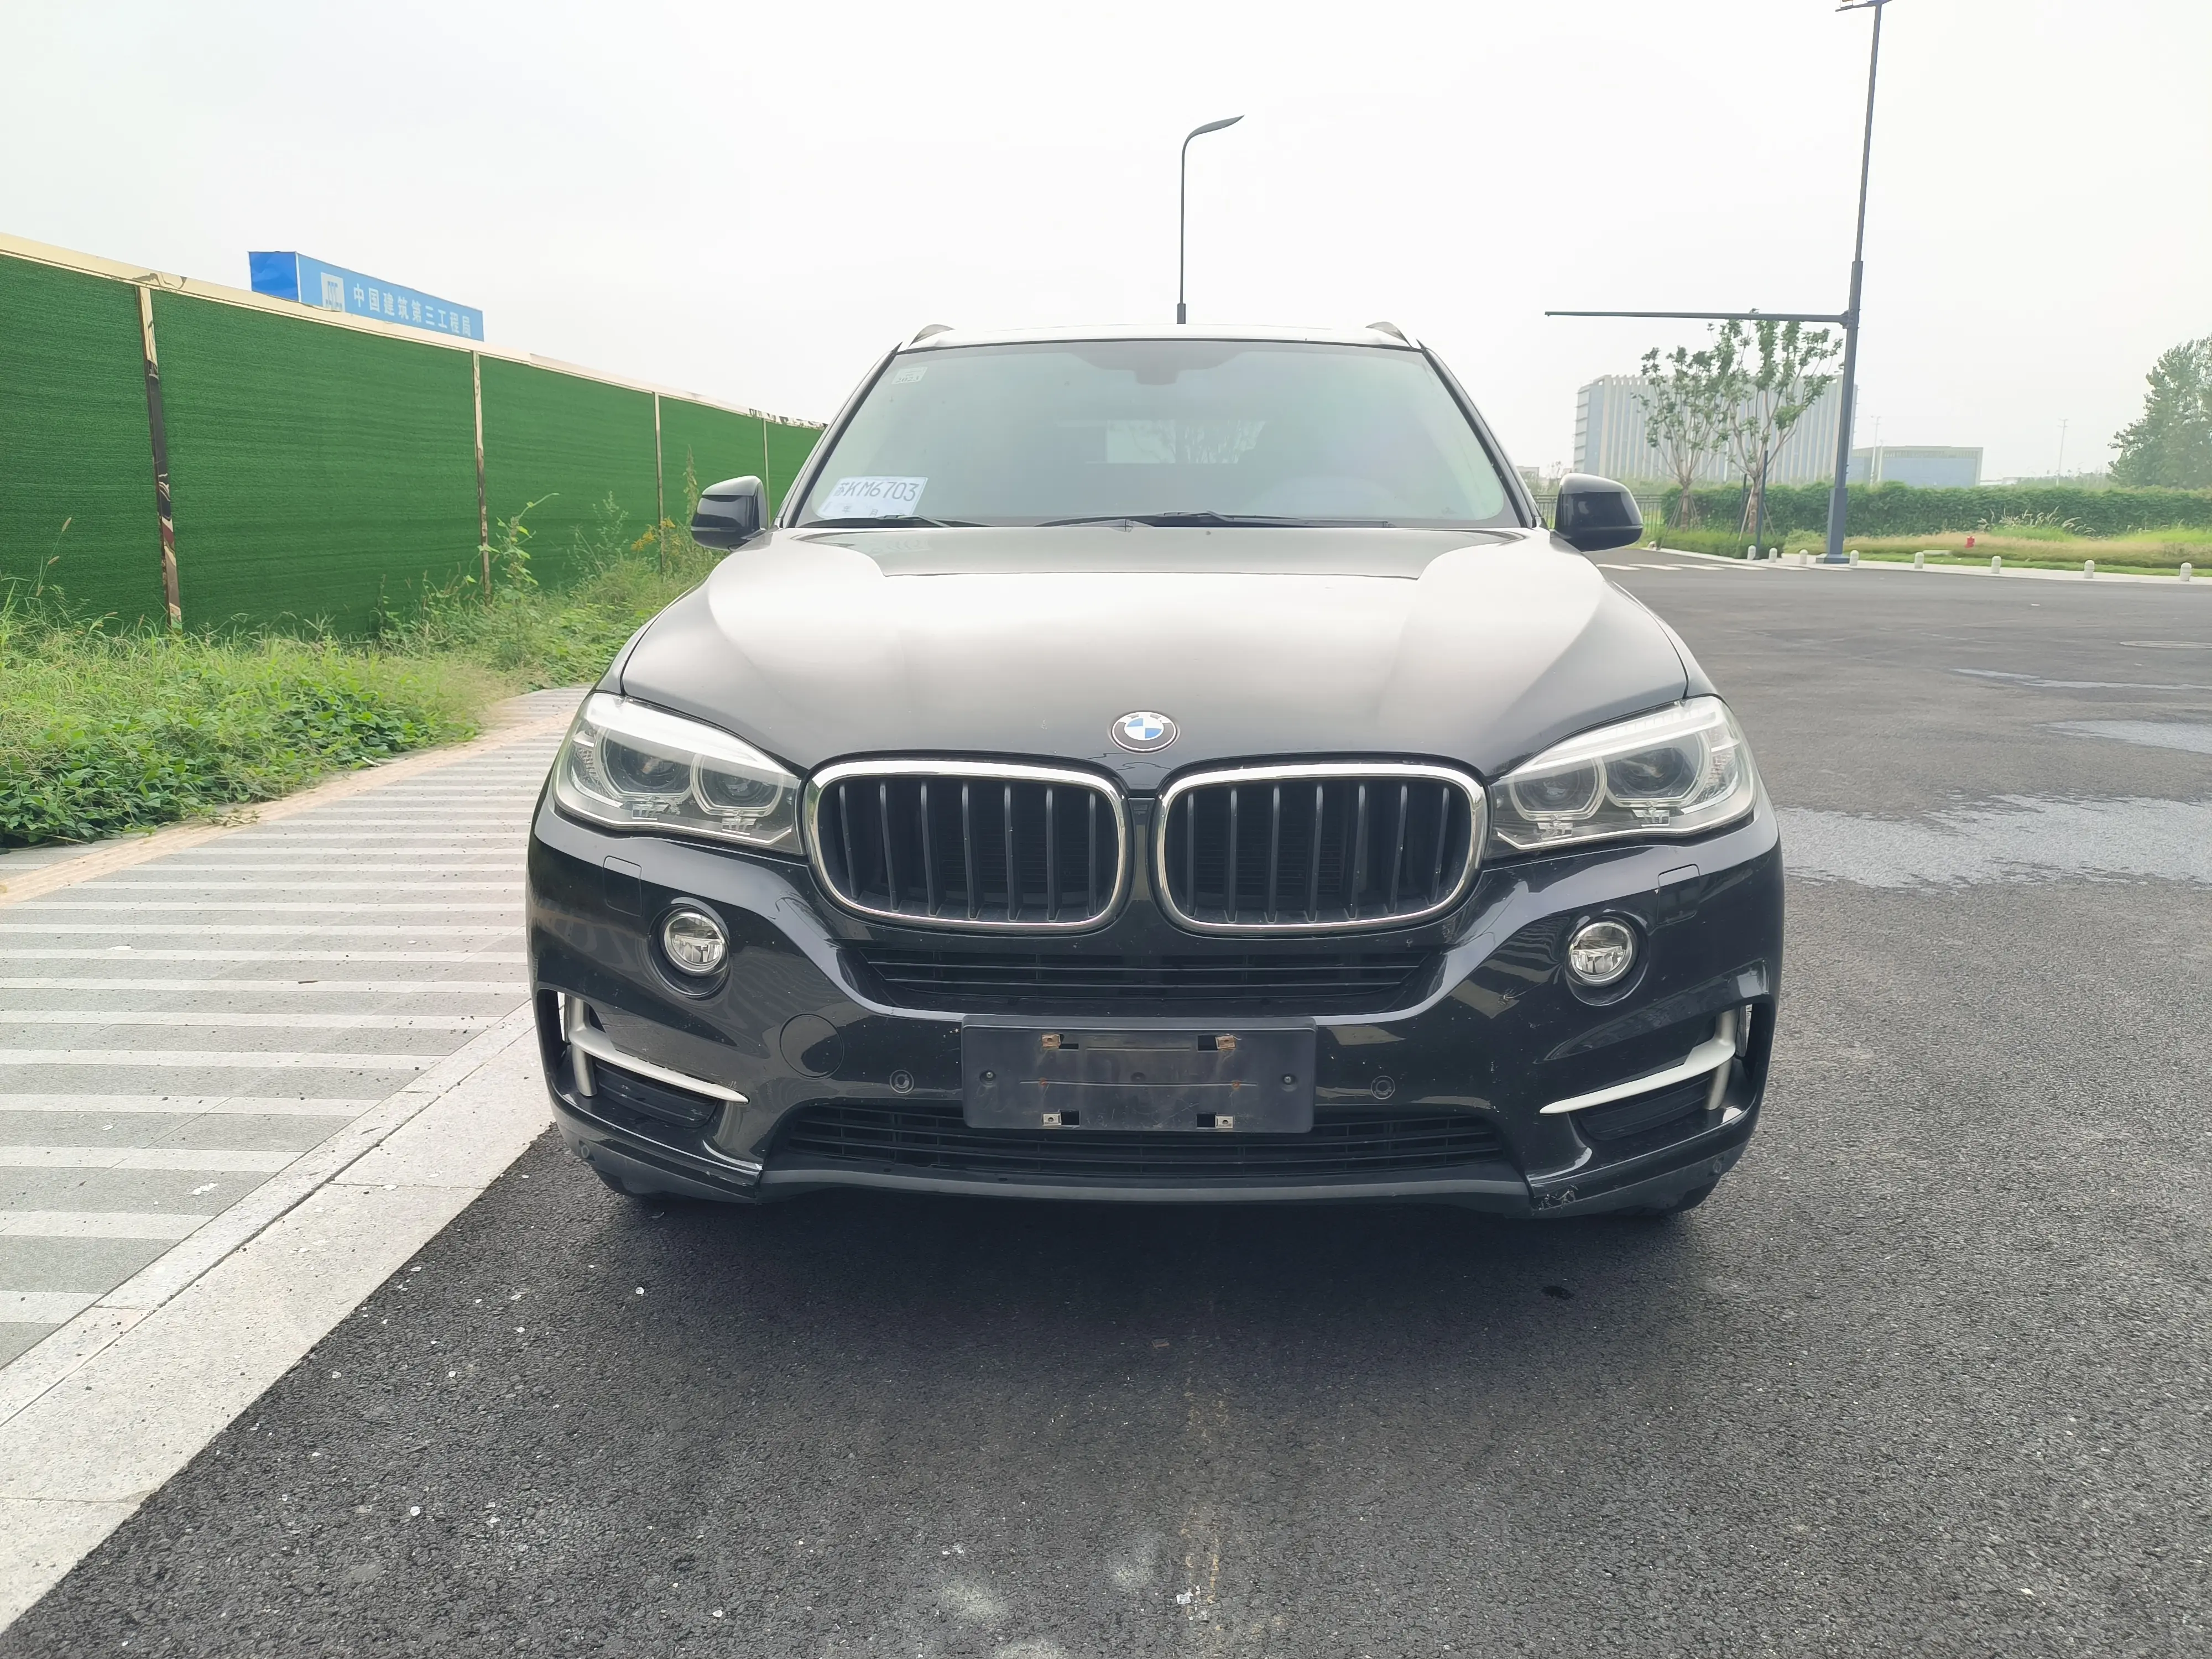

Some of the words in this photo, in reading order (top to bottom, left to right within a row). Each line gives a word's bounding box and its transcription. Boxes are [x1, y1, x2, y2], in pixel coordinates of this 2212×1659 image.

[353, 283, 471, 337] 中国建筑第三工程局
